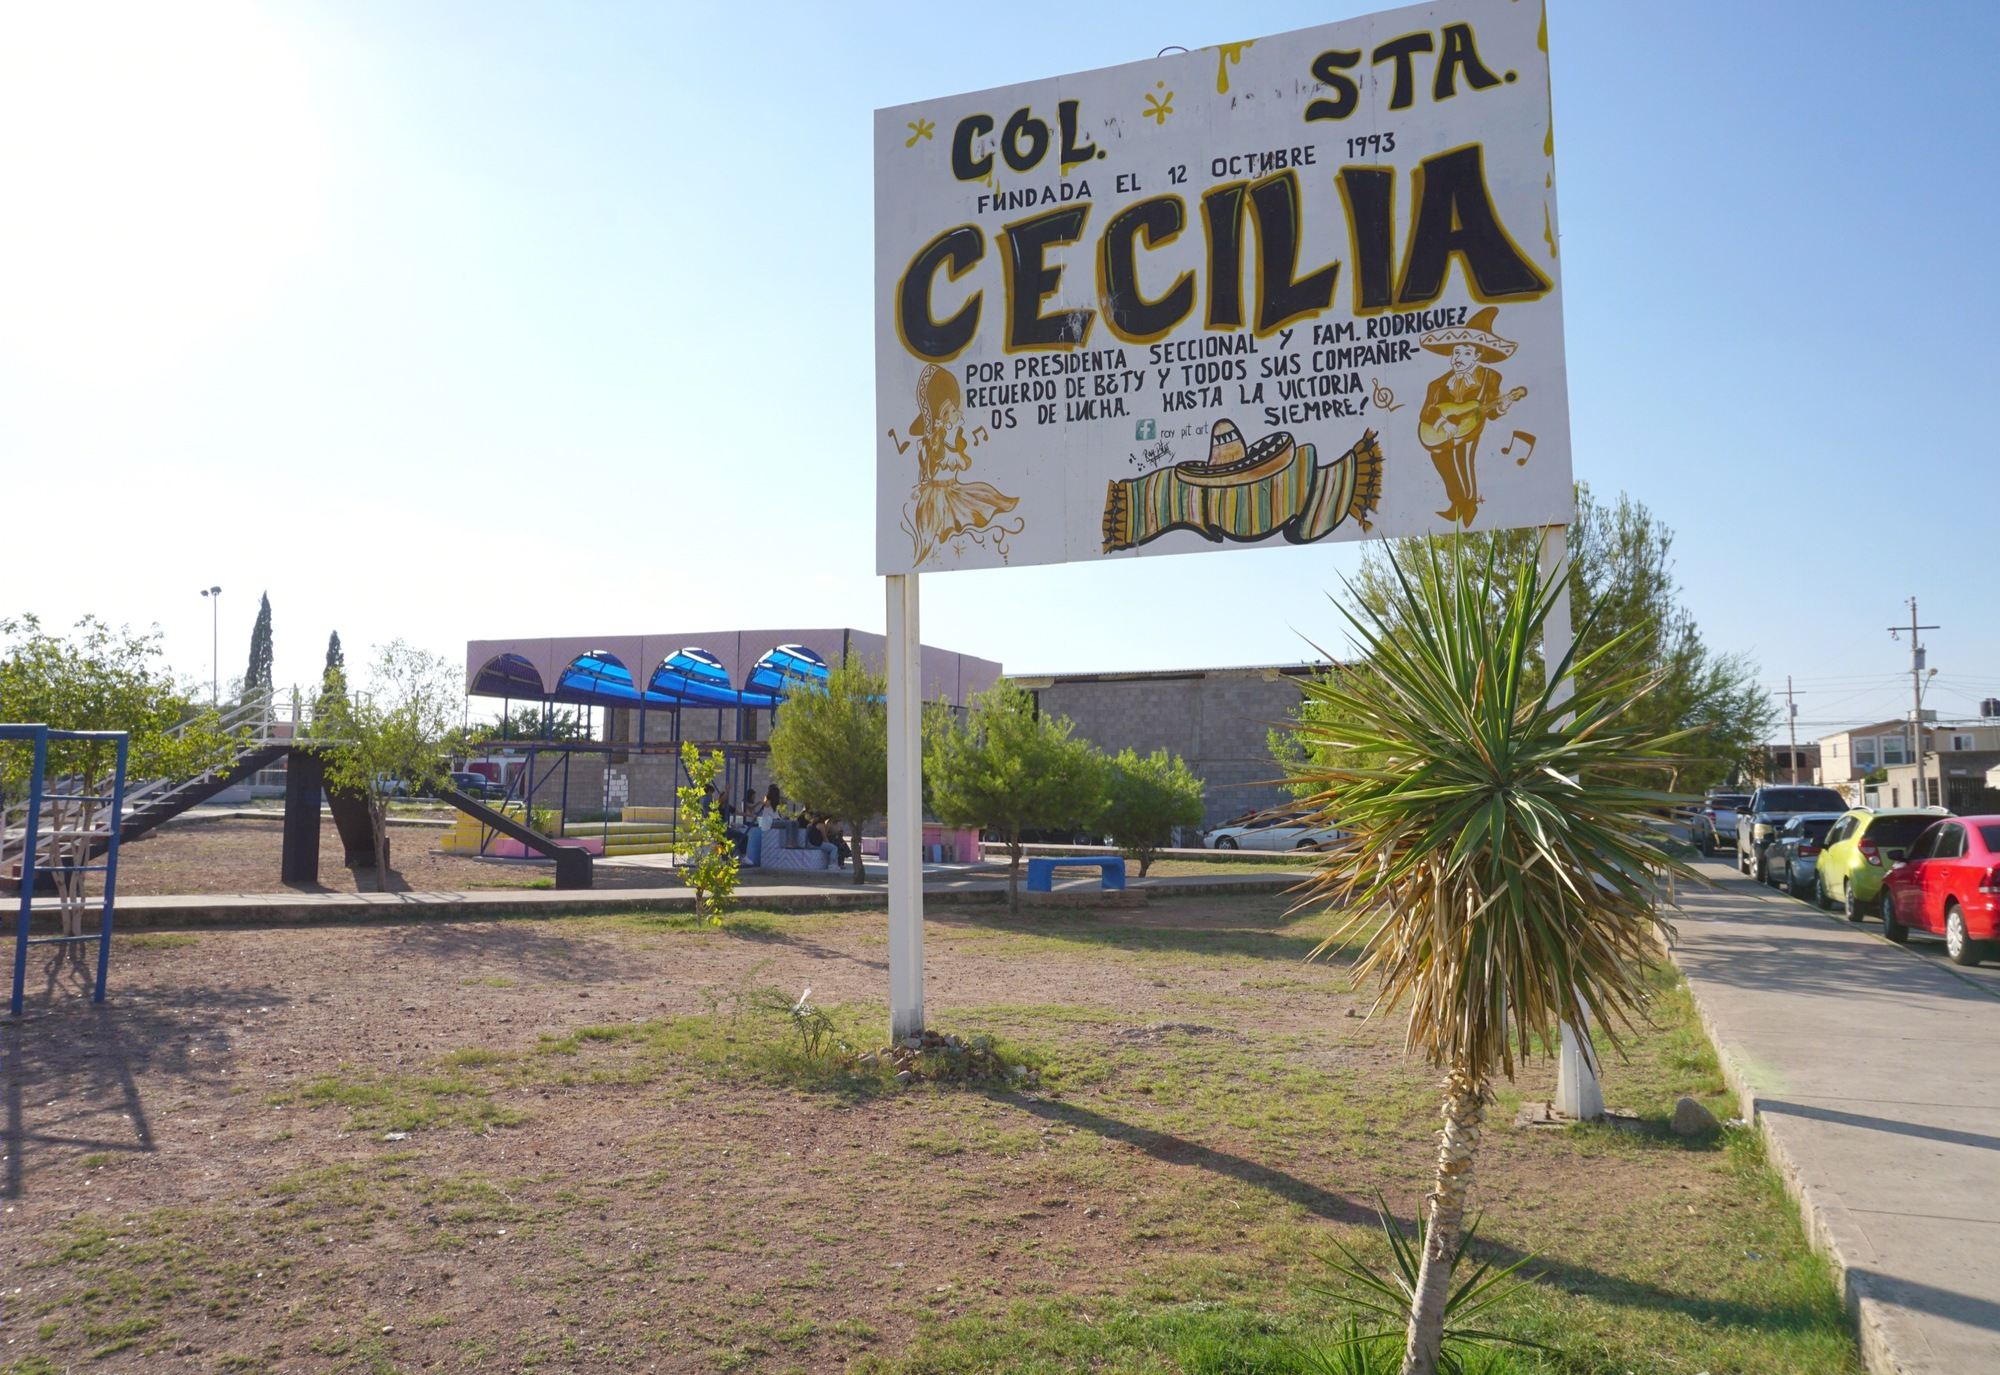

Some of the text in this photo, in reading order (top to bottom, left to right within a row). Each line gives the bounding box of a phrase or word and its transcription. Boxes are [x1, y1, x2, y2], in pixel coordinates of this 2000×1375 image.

[951, 21, 1519, 182] COL. STA.
[977, 132, 1396, 215] FUNDADA EL 12 OCTUBRE 1993
[895, 141, 1555, 364] CECILIA
[965, 306, 1468, 385] POR PRESIDENTA SECCIONAL Y FAM. RODRIGUEZ
[966, 380, 1057, 409] RECUERDO
[1065, 377, 1087, 400] DE
[1157, 367, 1171, 389] Y
[1180, 359, 1248, 387] TODOS
[1260, 353, 1302, 379] SUS
[991, 372, 1364, 430] OS DE LUCHA. HASTA LA VICTORIA
[1264, 395, 1370, 427] SIEMPRE!
[1160, 420, 1209, 440] ray pit art
